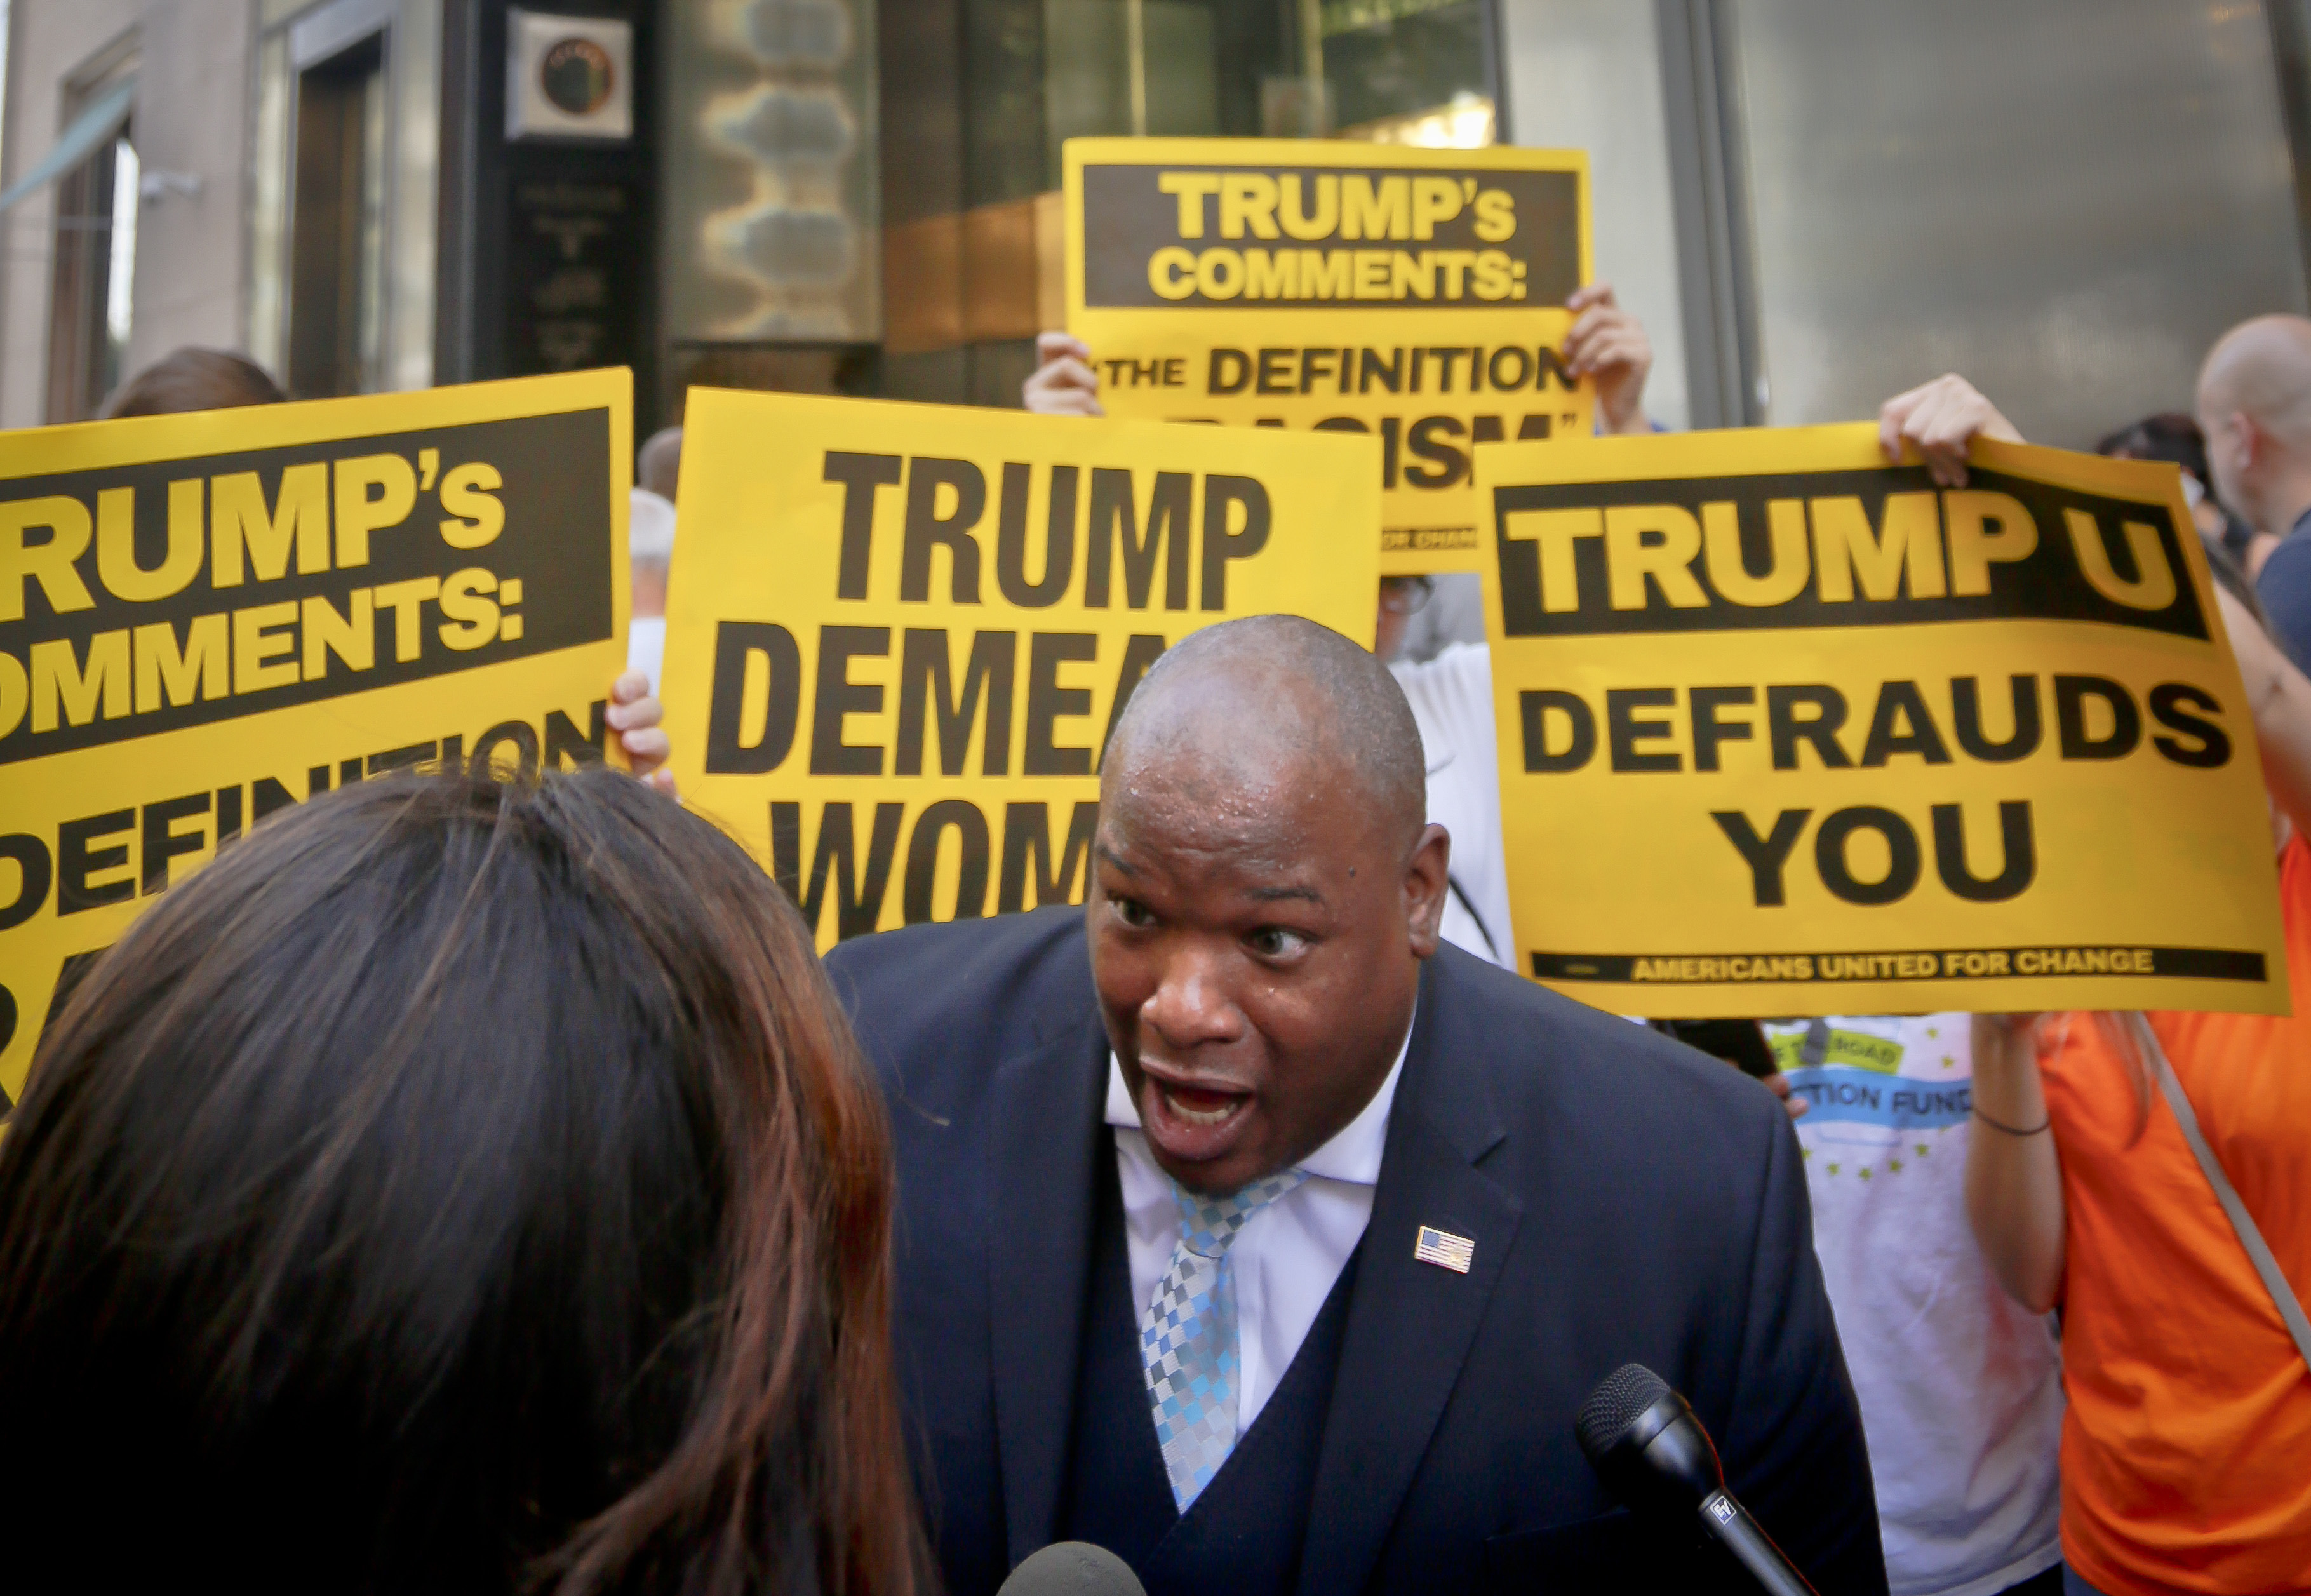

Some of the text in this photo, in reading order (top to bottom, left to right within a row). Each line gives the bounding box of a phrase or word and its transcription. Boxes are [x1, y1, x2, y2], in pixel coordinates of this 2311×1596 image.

[1158, 171, 1517, 242] TRUMP's
[1147, 246, 1528, 300] COMMENTS:
[1207, 346, 1579, 394] DEFINITION
[823, 450, 1273, 612] TRUMP
[1505, 491, 2180, 614] TRUMP U
[1518, 673, 2235, 773] DEFRAUDS
[770, 799, 1099, 948] WOM
[1709, 800, 2039, 908] YOU
[1631, 955, 1815, 982] AMERICANS
[1818, 953, 1939, 979] UNITED
[1943, 951, 2011, 976] FOR
[2014, 948, 2155, 974] CHANGE
